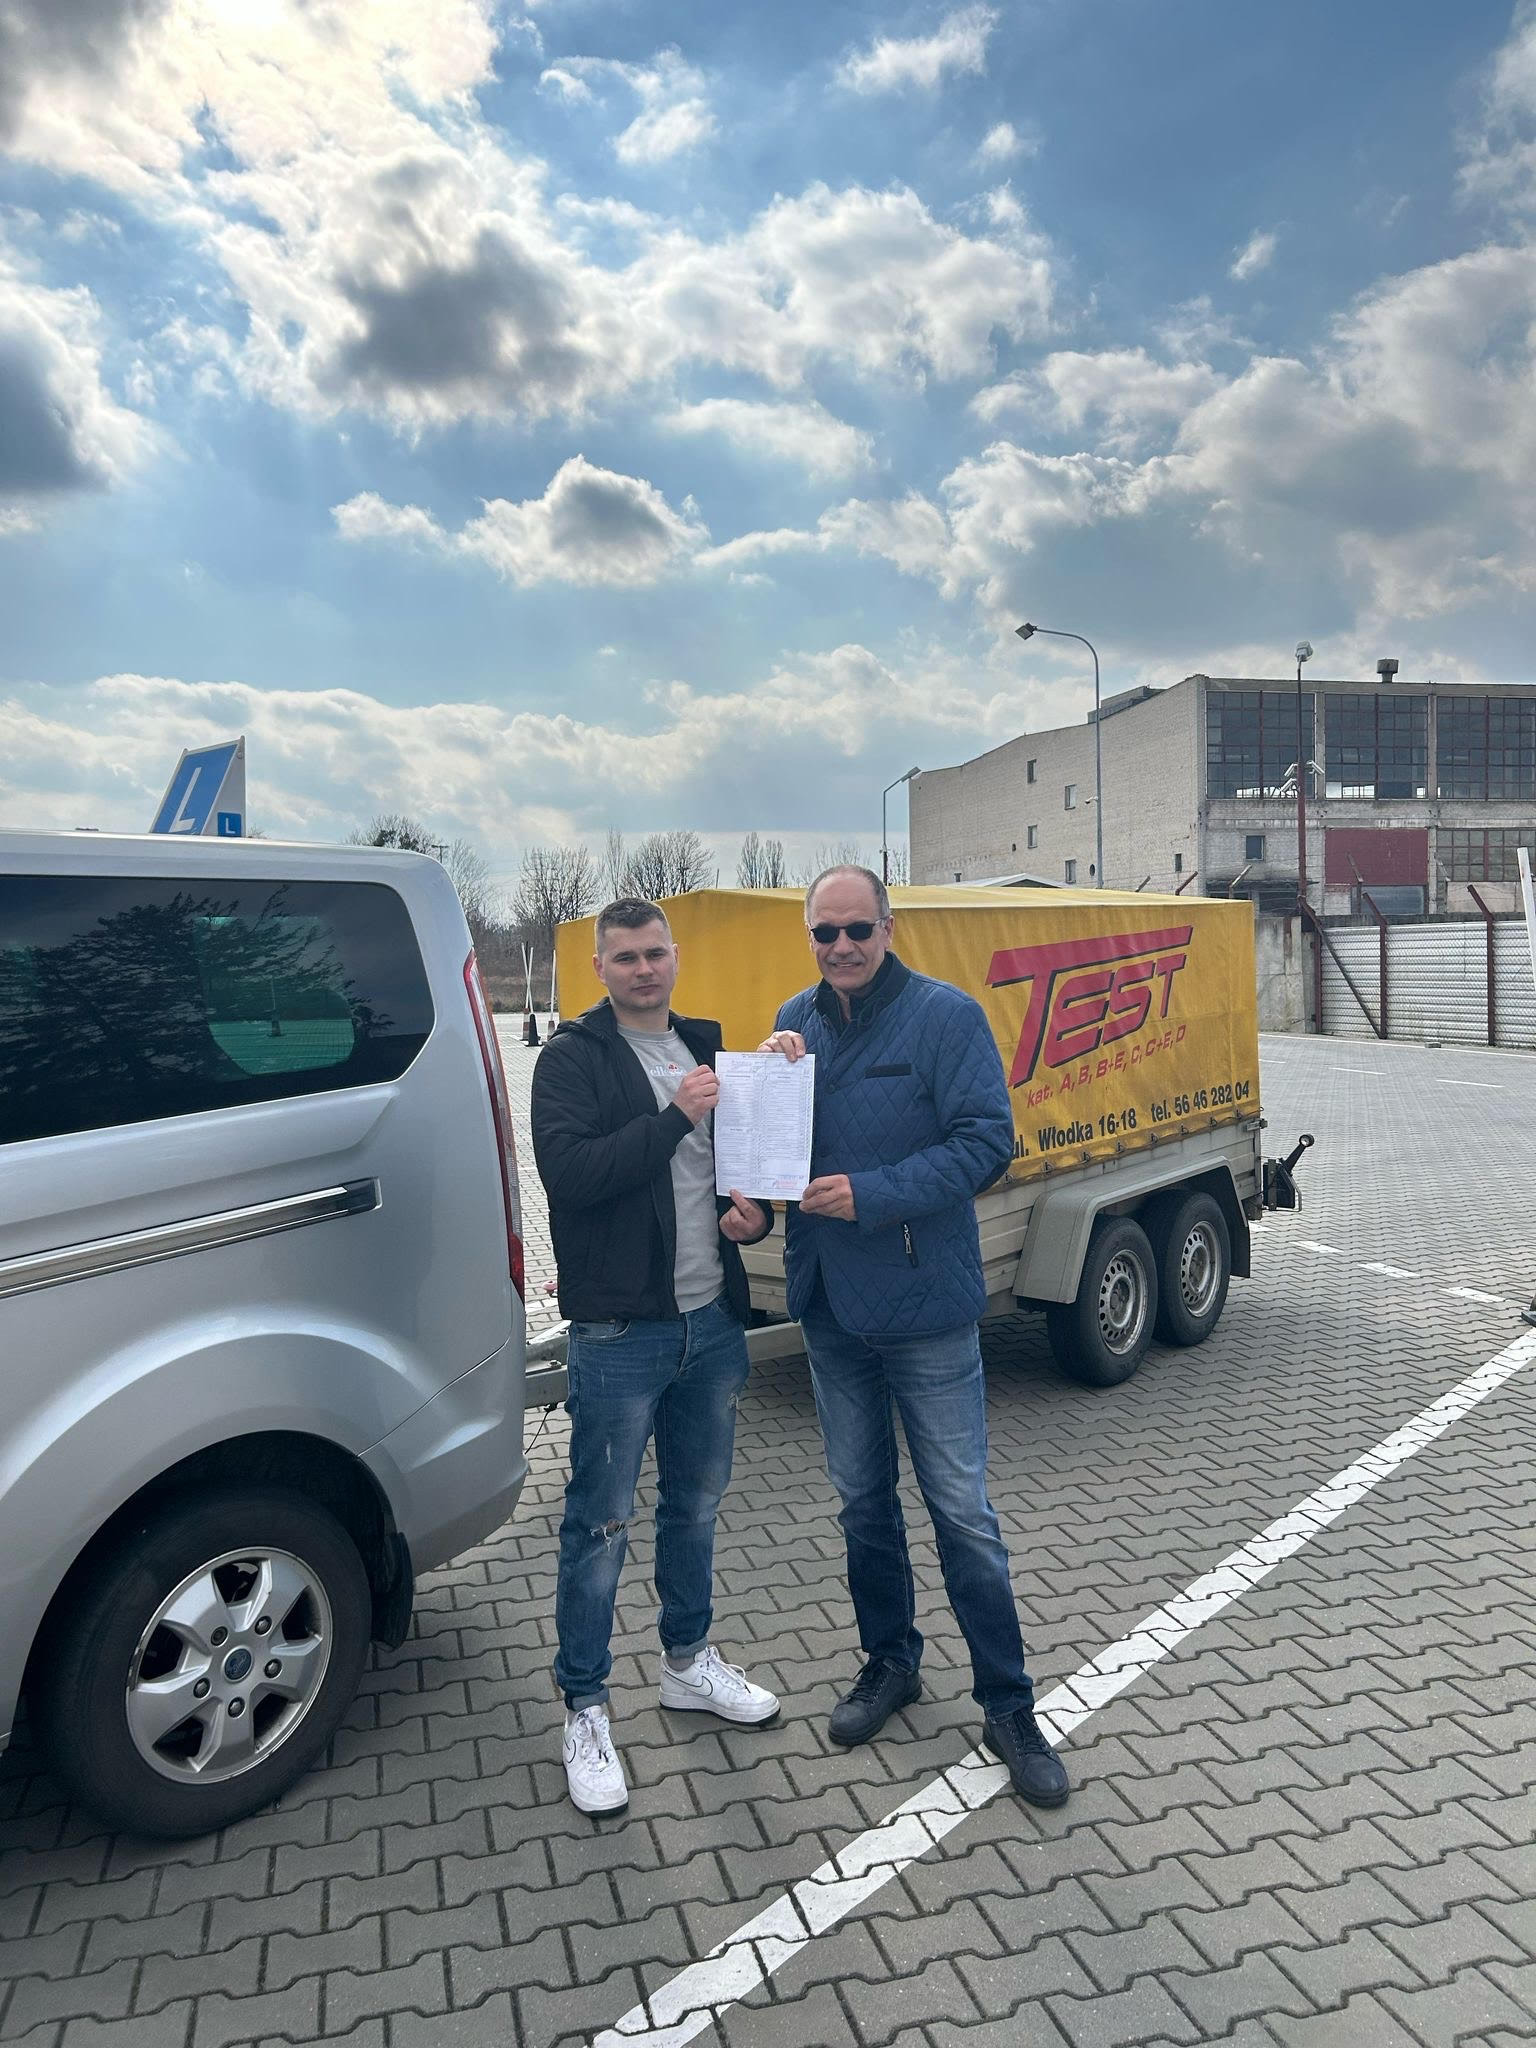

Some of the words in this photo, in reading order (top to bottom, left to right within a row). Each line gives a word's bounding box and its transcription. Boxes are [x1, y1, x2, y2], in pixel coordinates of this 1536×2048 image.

[225, 817, 236, 834] L
[985, 925, 1194, 1089] TEST
[1026, 1084, 1054, 1109] kat.
[1037, 1120, 1094, 1152] Włodka
[1098, 1108, 1137, 1137] 16-18
[1151, 1099, 1172, 1123] tel.
[1174, 1094, 1190, 1117] 56
[1193, 1089, 1208, 1111] 46
[1211, 1083, 1233, 1107] 282
[1235, 1080, 1250, 1101] 04
